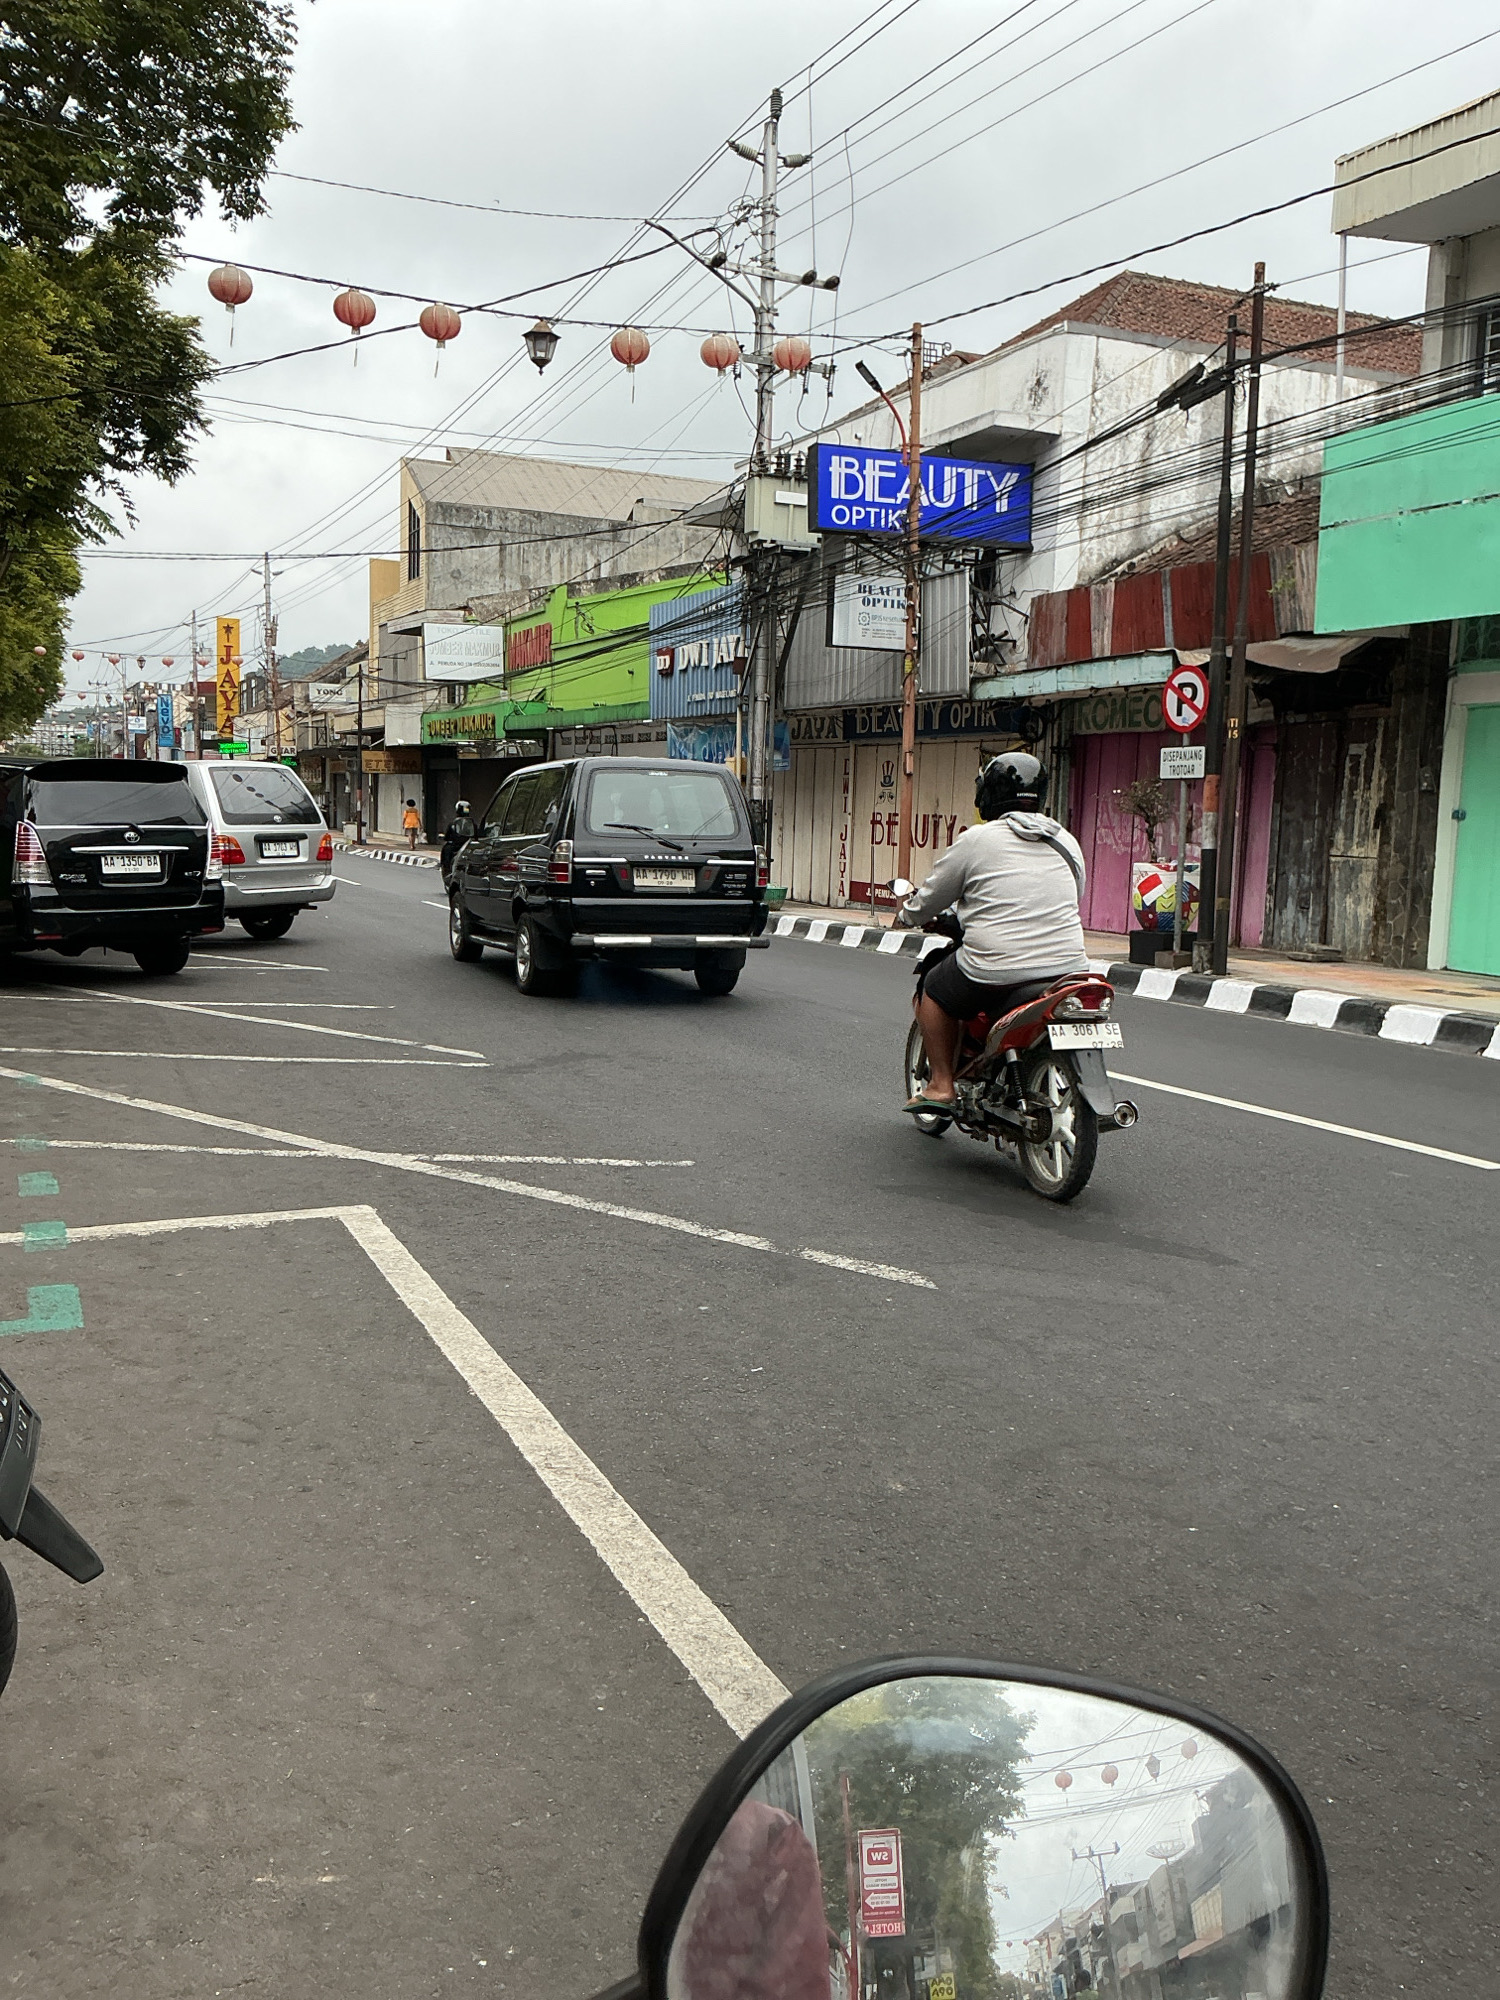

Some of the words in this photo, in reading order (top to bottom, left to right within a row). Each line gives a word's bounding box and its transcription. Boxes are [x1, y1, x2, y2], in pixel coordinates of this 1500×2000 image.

[829, 455, 1021, 513] BEAUTY
[857, 584, 906, 597] BEAUT
[861, 596, 906, 610] OPTIK
[437, 626, 459, 634] TOKO
[507, 622, 553, 672] MAKMUR
[678, 640, 709, 671] DWI
[219, 645, 239, 734] JAYA
[316, 688, 343, 696] YONG
[160, 697, 171, 734] Nevo
[949, 701, 998, 729] OPTIK
[1077, 694, 1164, 731] ROMEO
[427, 719, 458, 736] SUMBER
[458, 713, 495, 734] MAKMUR
[791, 716, 838, 740] JAYA
[1163, 749, 1202, 763] DISEPANJANG
[1169, 764, 1195, 776] TROTOAR
[103, 856, 115, 867] AA
[120, 856, 143, 867] 1350
[147, 855, 158, 867] BA
[838, 824, 848, 898] JAYA
[635, 868, 648, 880] AA
[652, 868, 677, 880] 1790
[682, 869, 694, 881] WH
[1051, 1025, 1066, 1037] AA
[1072, 1023, 1099, 1036] 3061
[1104, 1023, 1120, 1035] SE
